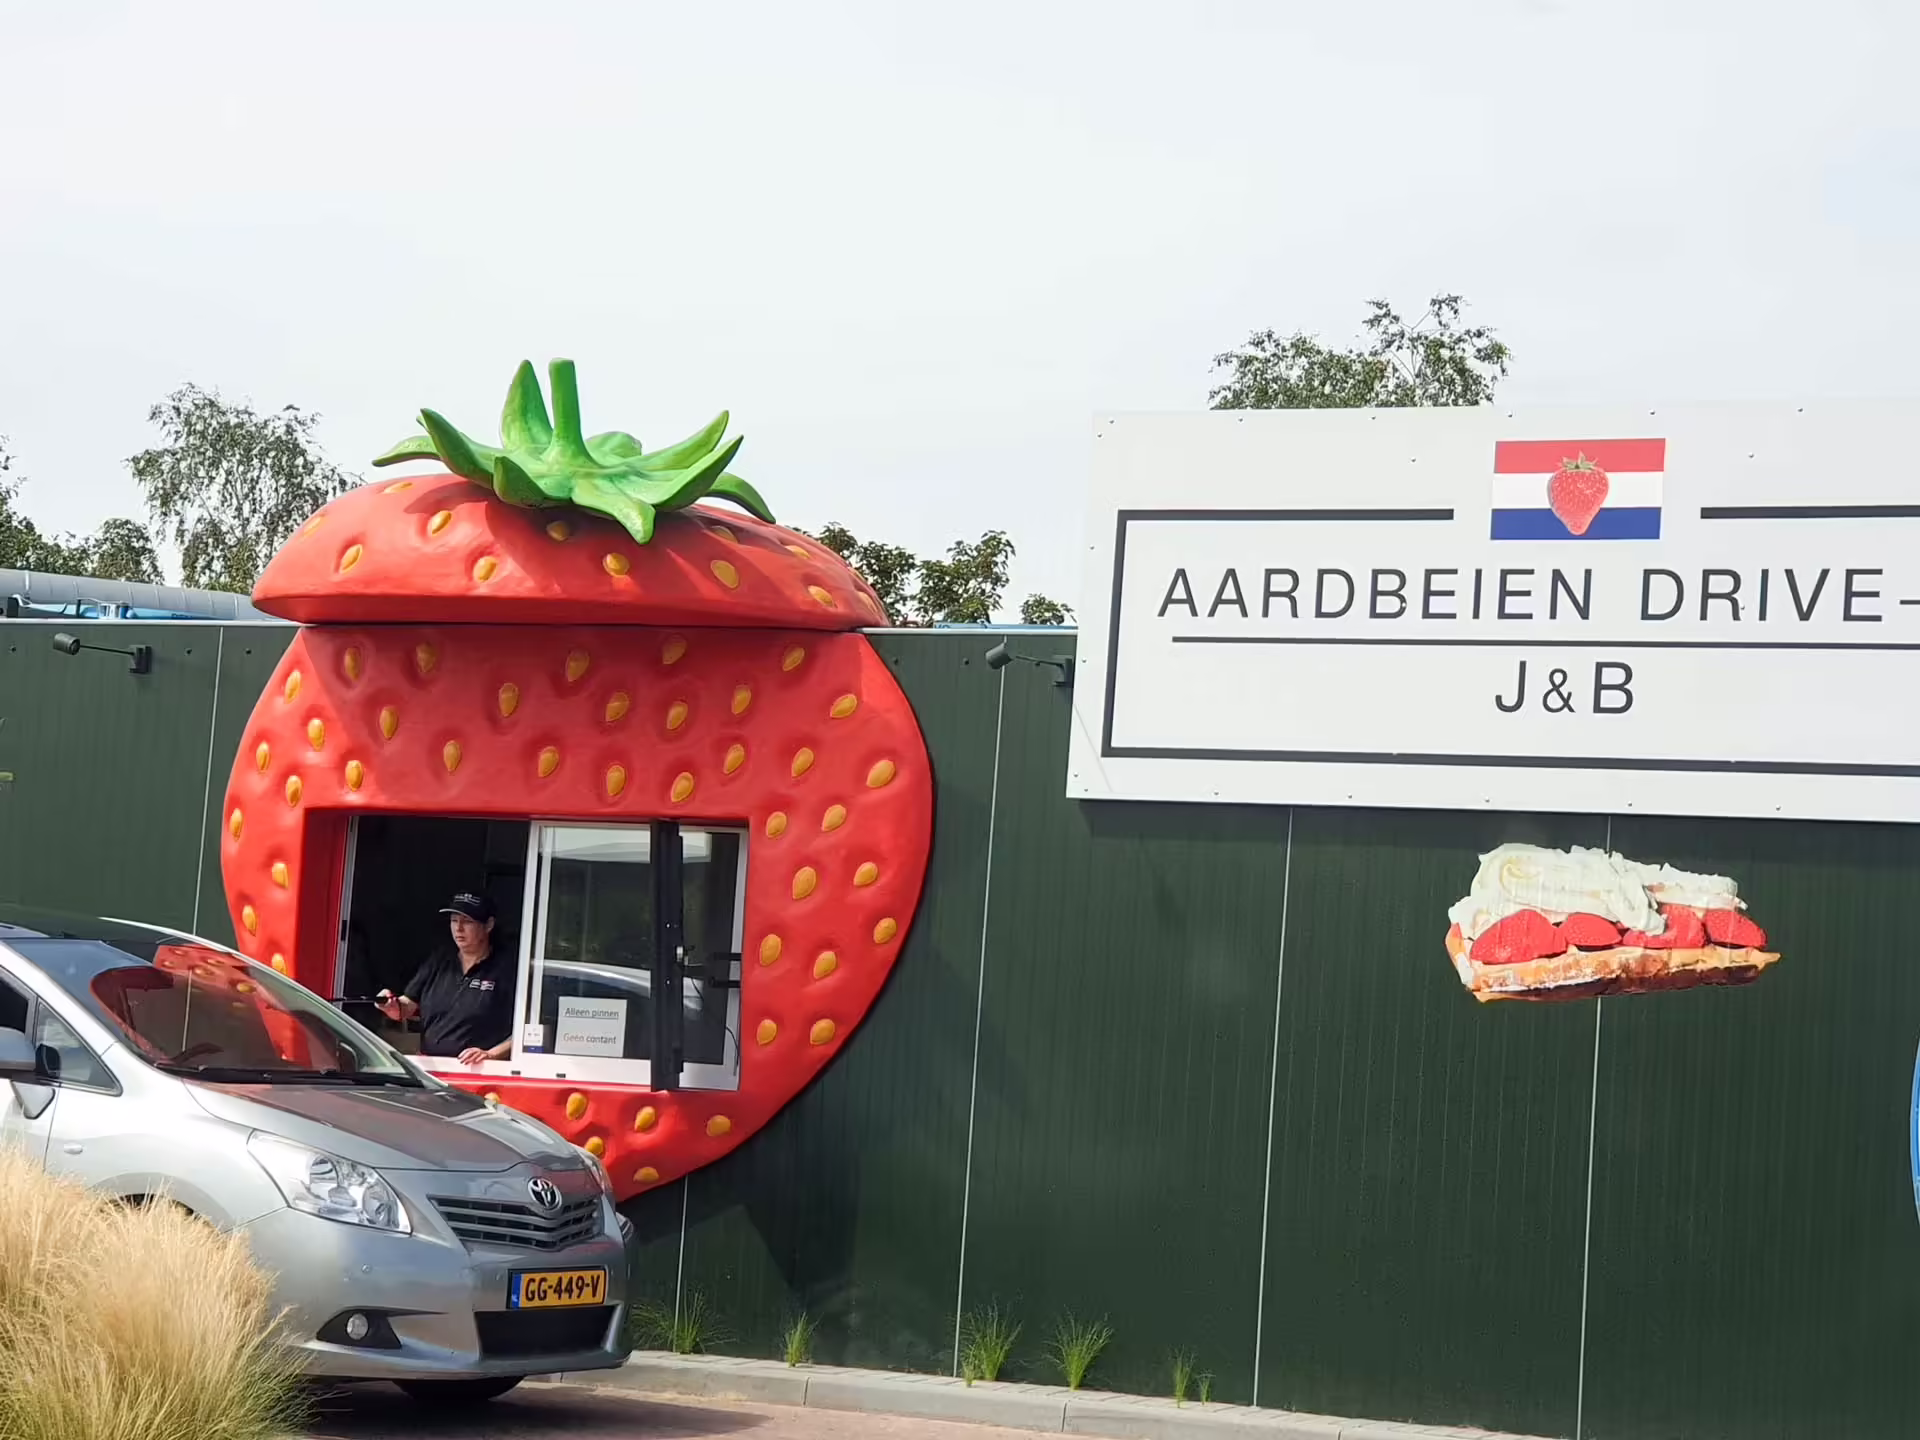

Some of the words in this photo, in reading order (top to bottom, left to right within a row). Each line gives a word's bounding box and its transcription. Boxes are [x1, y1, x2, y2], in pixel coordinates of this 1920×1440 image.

[1157, 567, 1593, 621] AARDBEIEN
[1494, 660, 1635, 715] J&B
[564, 1007, 590, 1018] Alleen
[591, 1009, 619, 1019] pinnen
[563, 1033, 584, 1042] Geen
[585, 1035, 617, 1045] contant
[525, 1274, 601, 1302] GG-449-V
